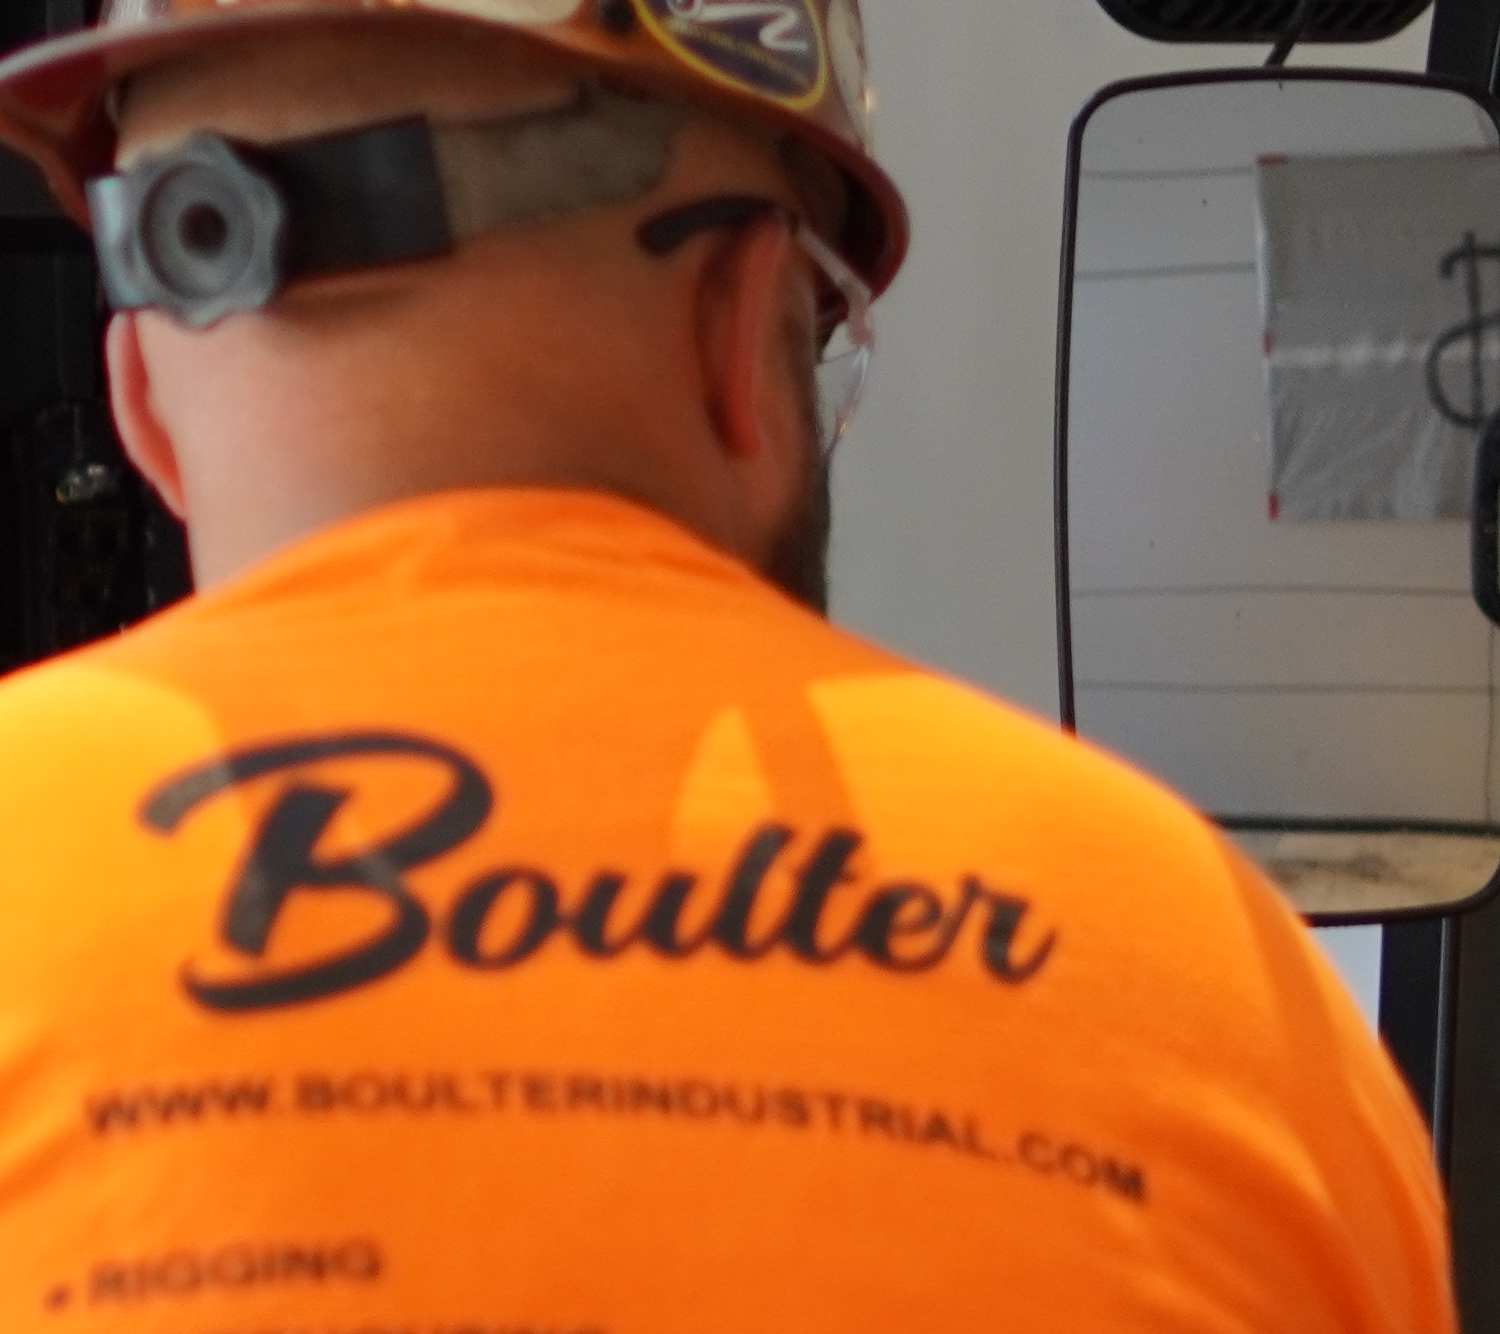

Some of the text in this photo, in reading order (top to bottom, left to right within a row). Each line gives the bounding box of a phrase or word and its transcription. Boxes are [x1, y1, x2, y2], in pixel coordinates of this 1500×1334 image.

[136, 729, 1056, 1016] Boulter
[85, 1070, 1150, 1207] WWW.BOULTERINDUSTRIAL.COM
[85, 1237, 384, 1305] RIGGING
